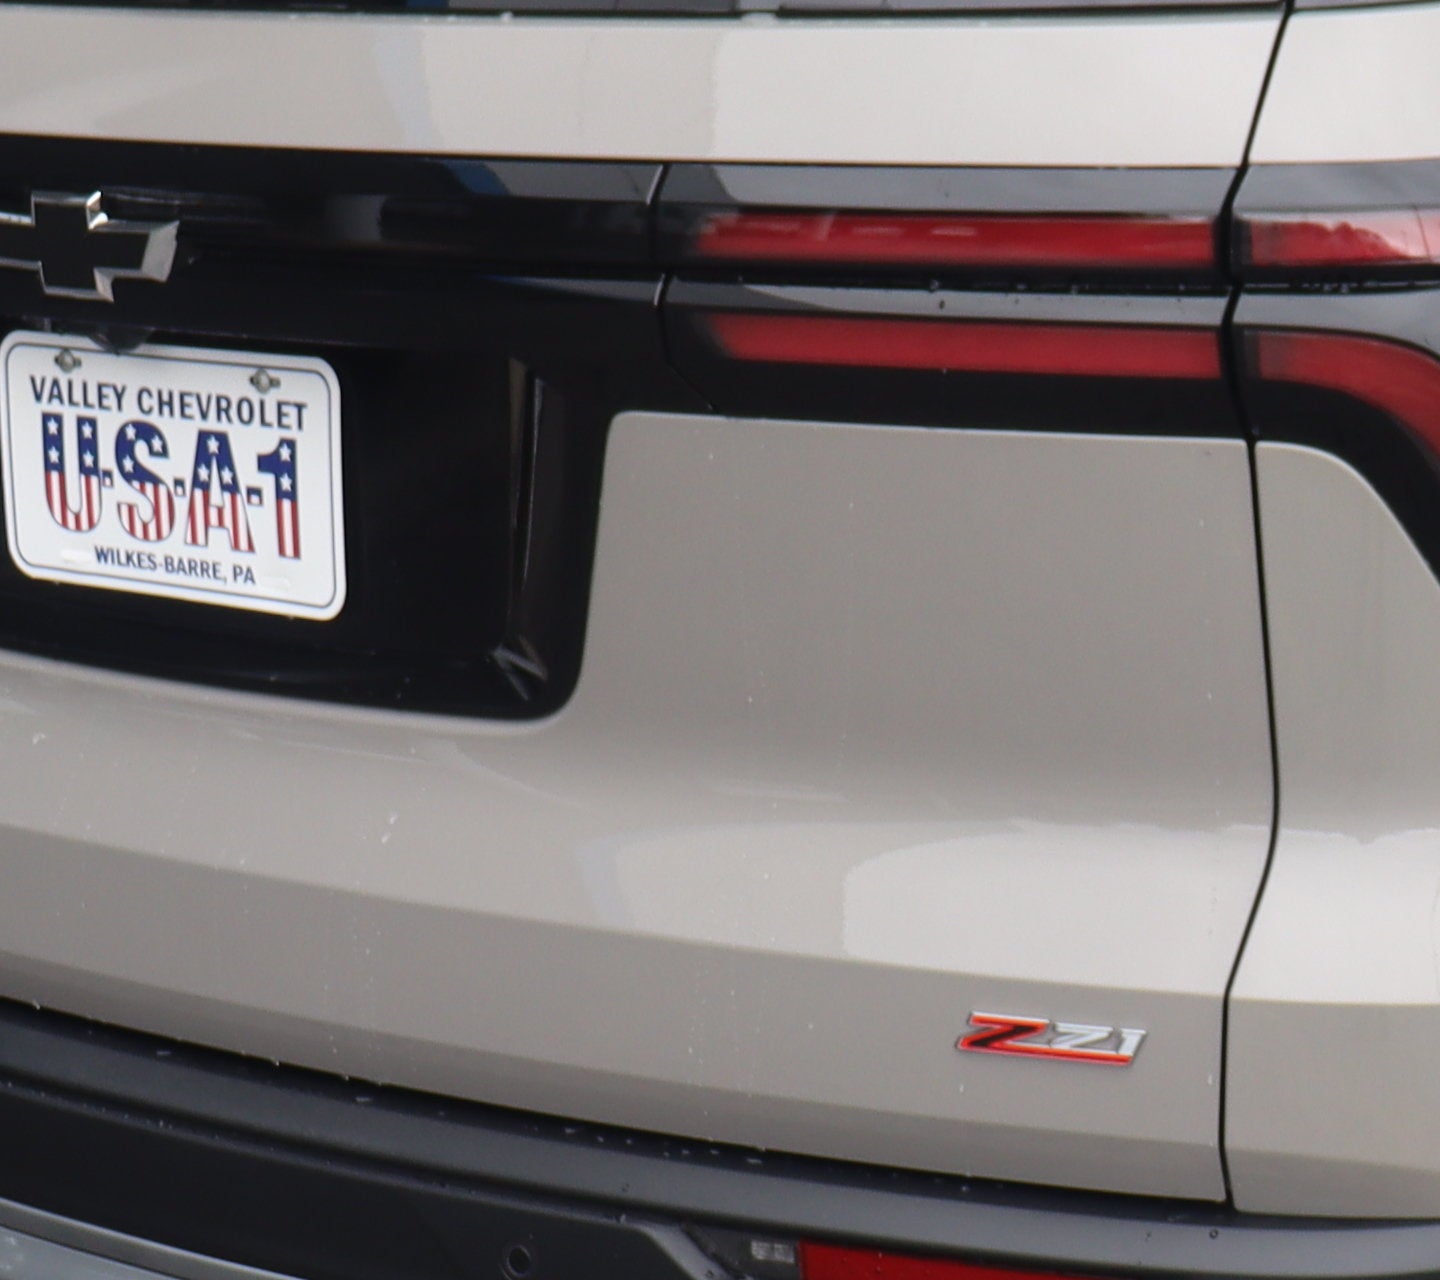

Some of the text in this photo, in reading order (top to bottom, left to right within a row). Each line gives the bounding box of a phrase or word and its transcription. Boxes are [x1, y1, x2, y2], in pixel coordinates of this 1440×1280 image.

[29, 374, 308, 432] VALLEY CHEVROLET
[94, 545, 256, 584] WILKES-BARRE, PA
[956, 1010, 1147, 1066] Z71
